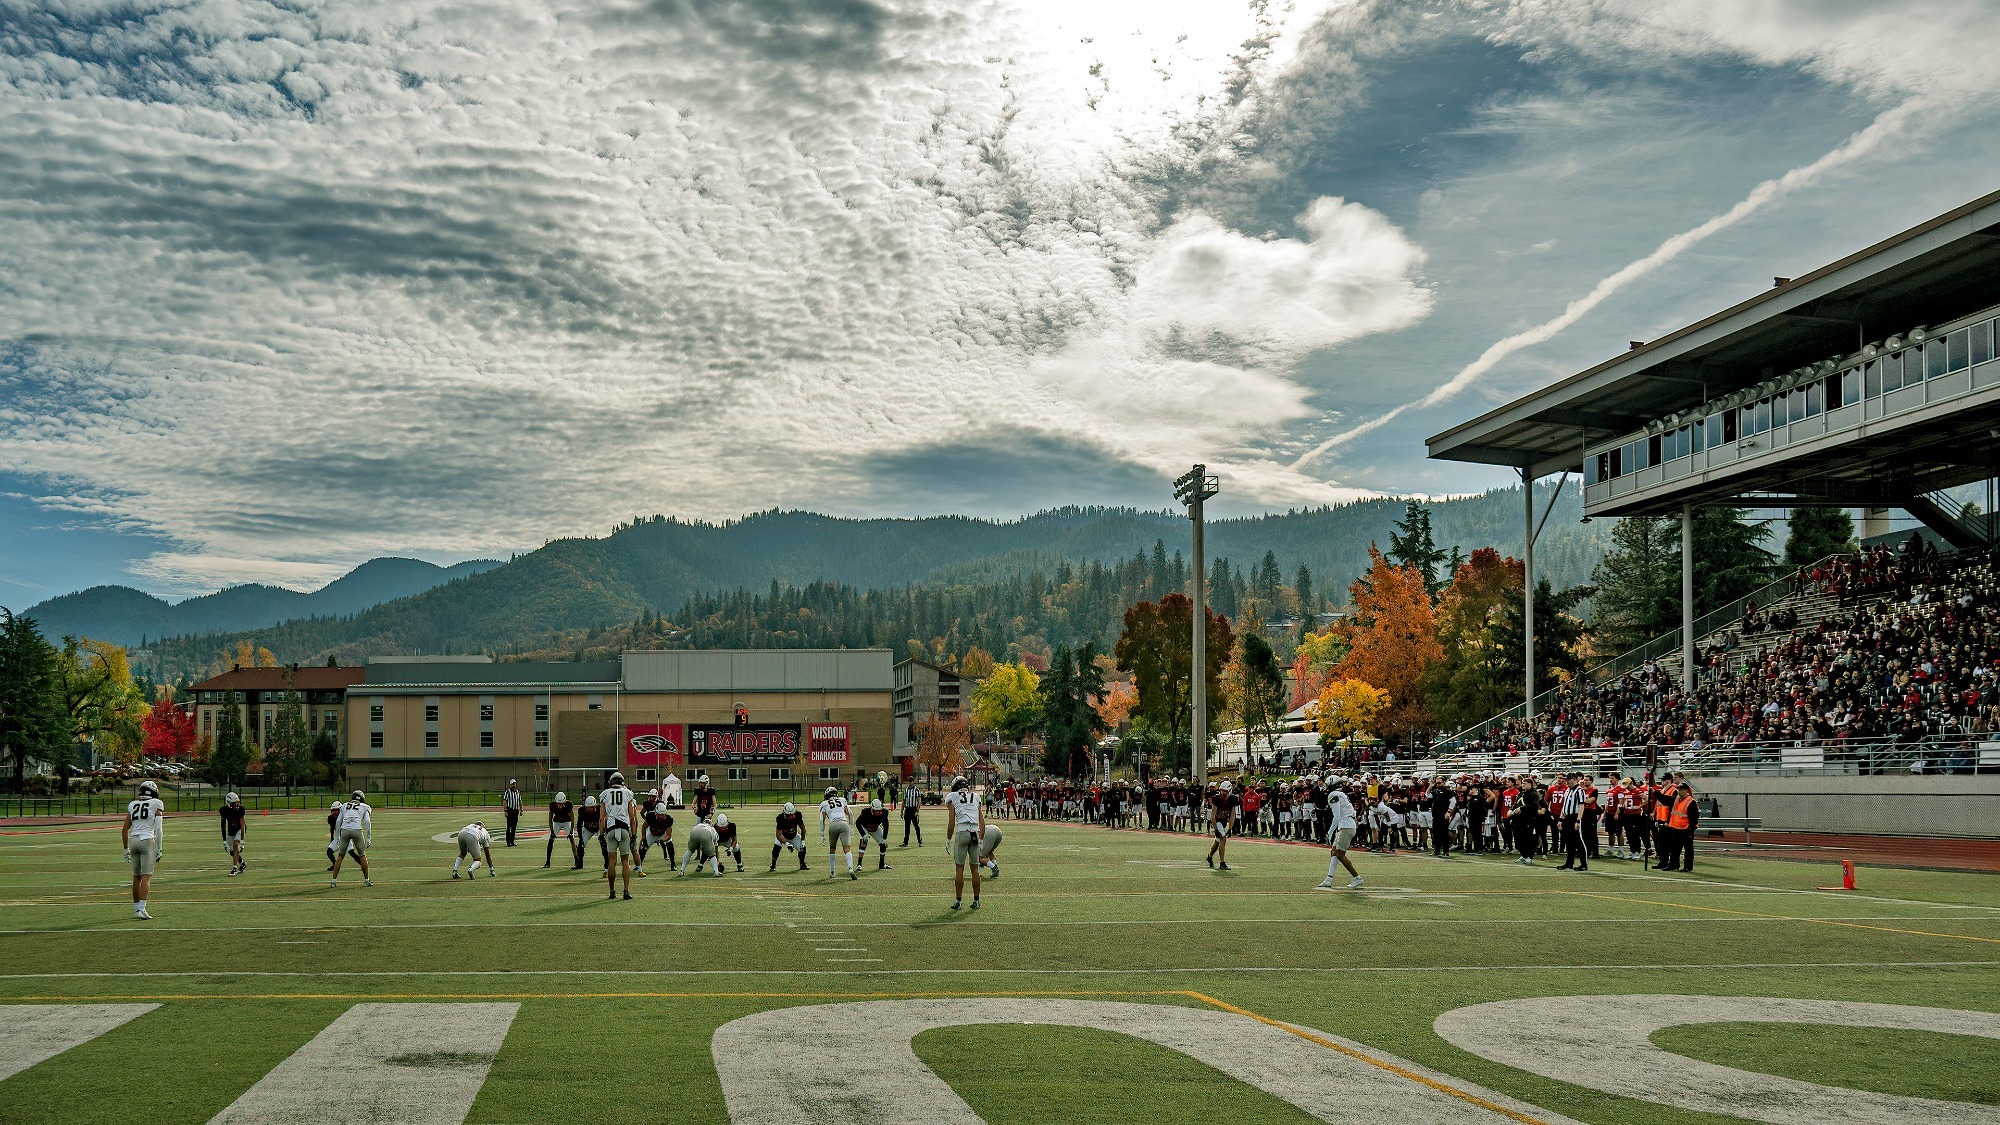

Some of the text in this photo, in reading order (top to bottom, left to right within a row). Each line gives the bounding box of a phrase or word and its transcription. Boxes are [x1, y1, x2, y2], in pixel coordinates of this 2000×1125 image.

[811, 726, 847, 739] WISDOM
[707, 731, 797, 760] RAIDERS
[811, 739, 846, 751] COURAGE
[811, 751, 847, 761] CHARACTER
[610, 790, 622, 805] 10
[1552, 793, 1564, 804] 67
[827, 798, 842, 810] 55
[132, 803, 149, 820] 26
